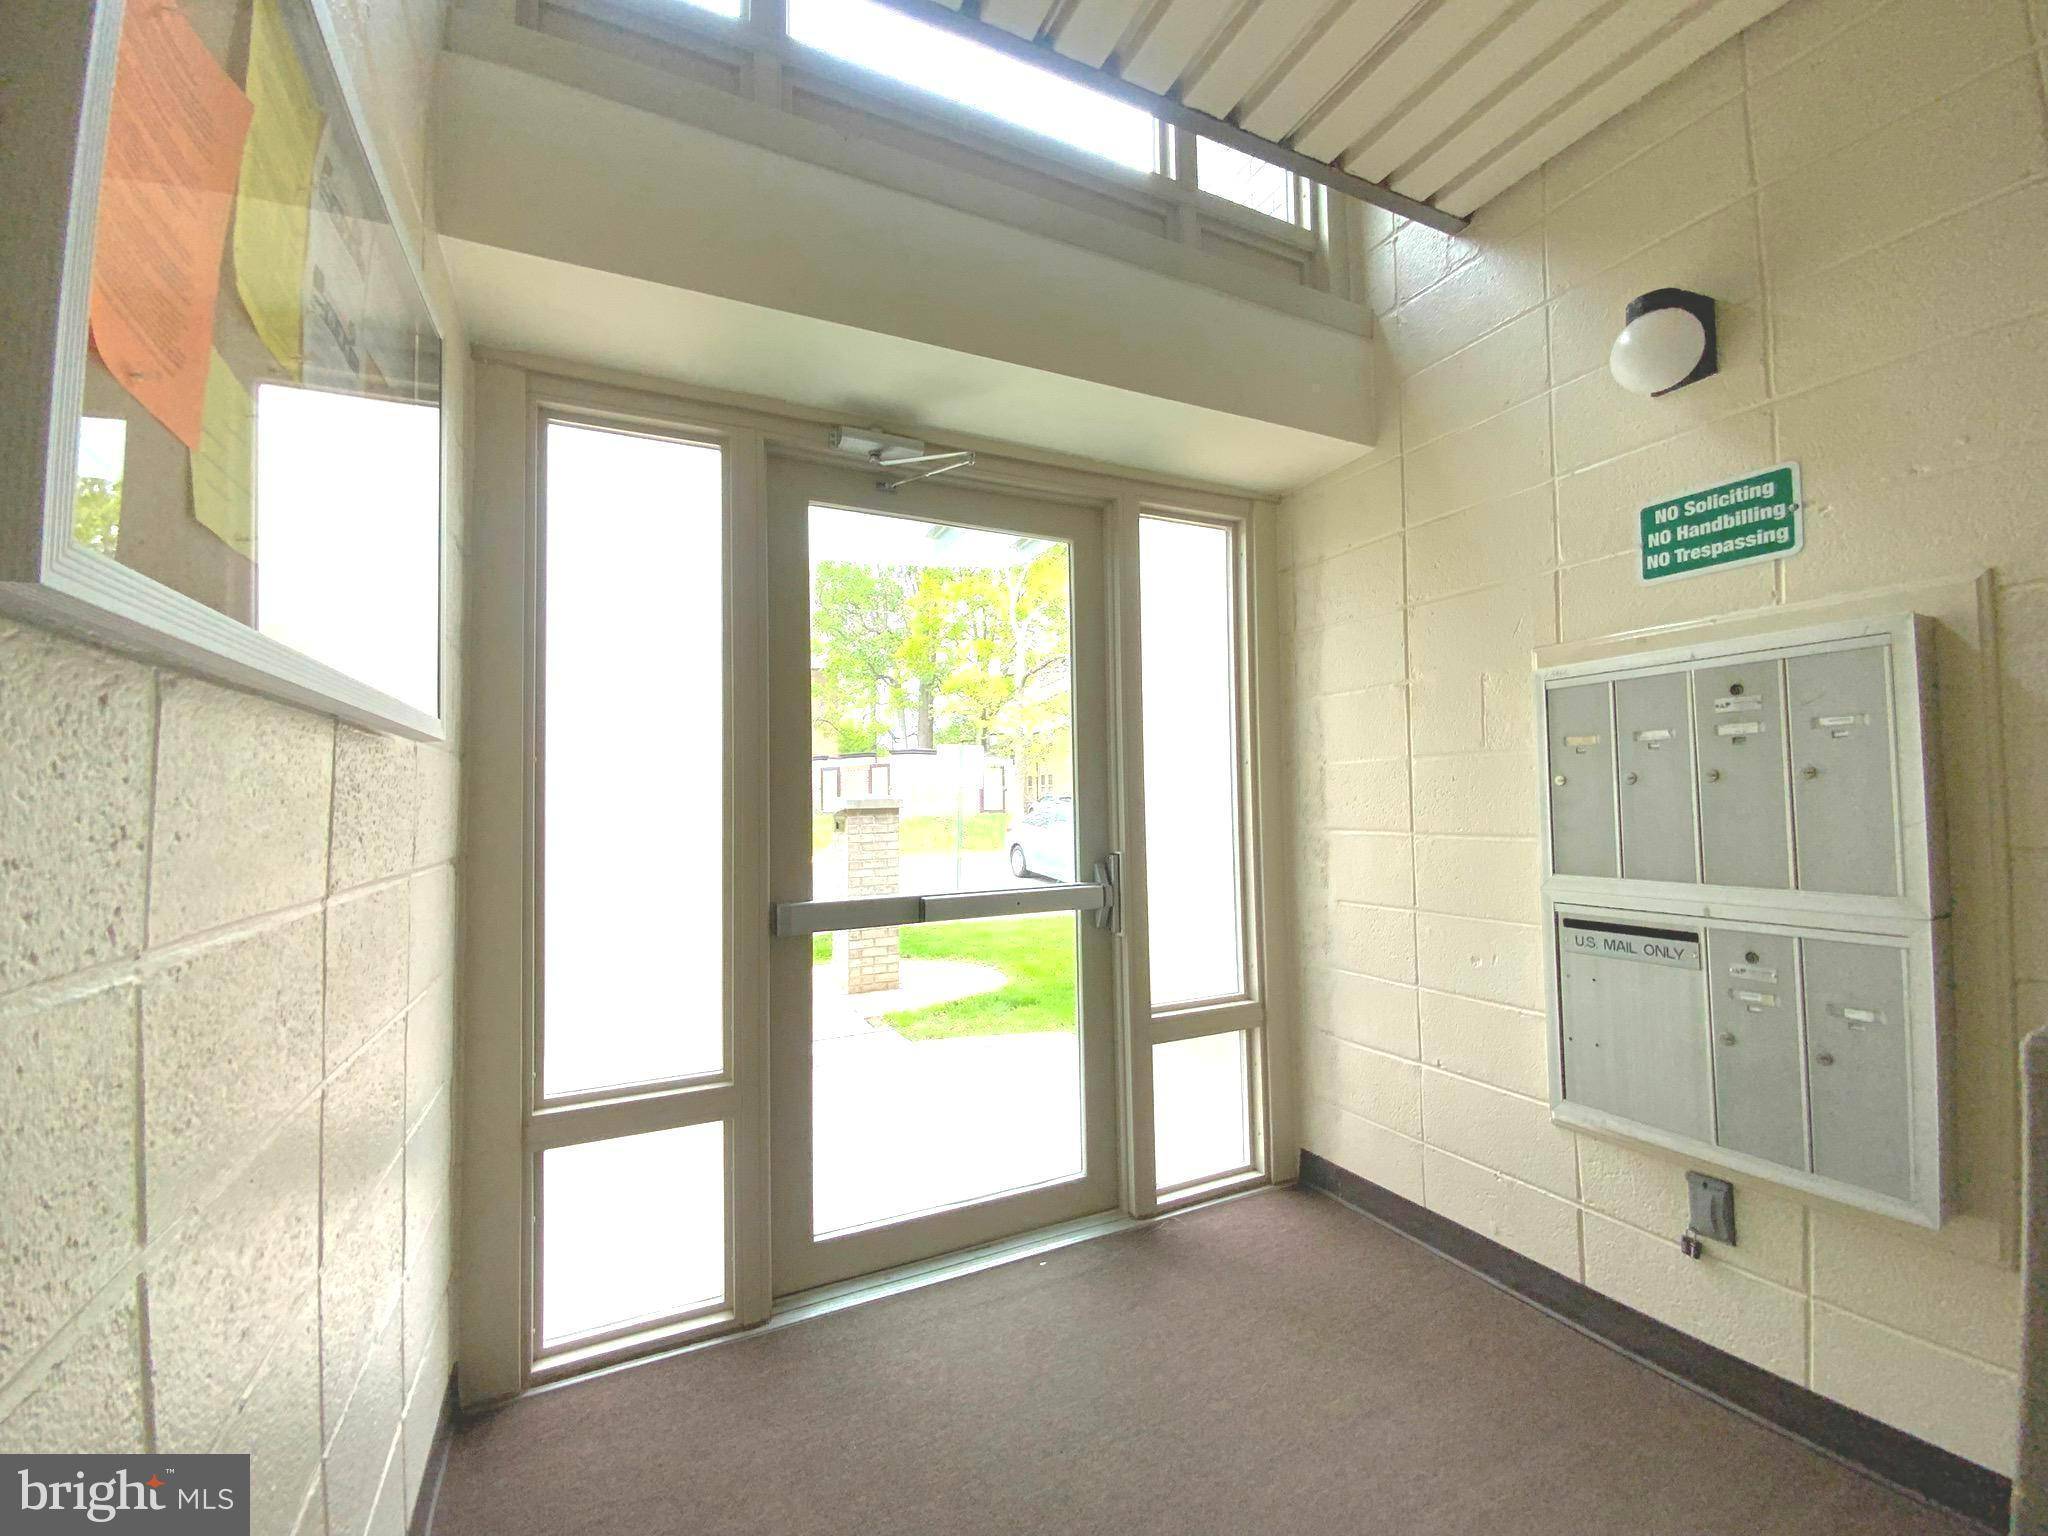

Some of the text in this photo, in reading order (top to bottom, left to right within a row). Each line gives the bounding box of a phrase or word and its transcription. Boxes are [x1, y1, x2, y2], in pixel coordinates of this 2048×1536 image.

[1655, 481, 1775, 524] NO Soliciting
[1647, 502, 1786, 548] NO Handbilling
[1646, 527, 1790, 570] NO Trespassing
[1603, 939, 1638, 954] MAIL
[1643, 944, 1685, 960] ONLY
